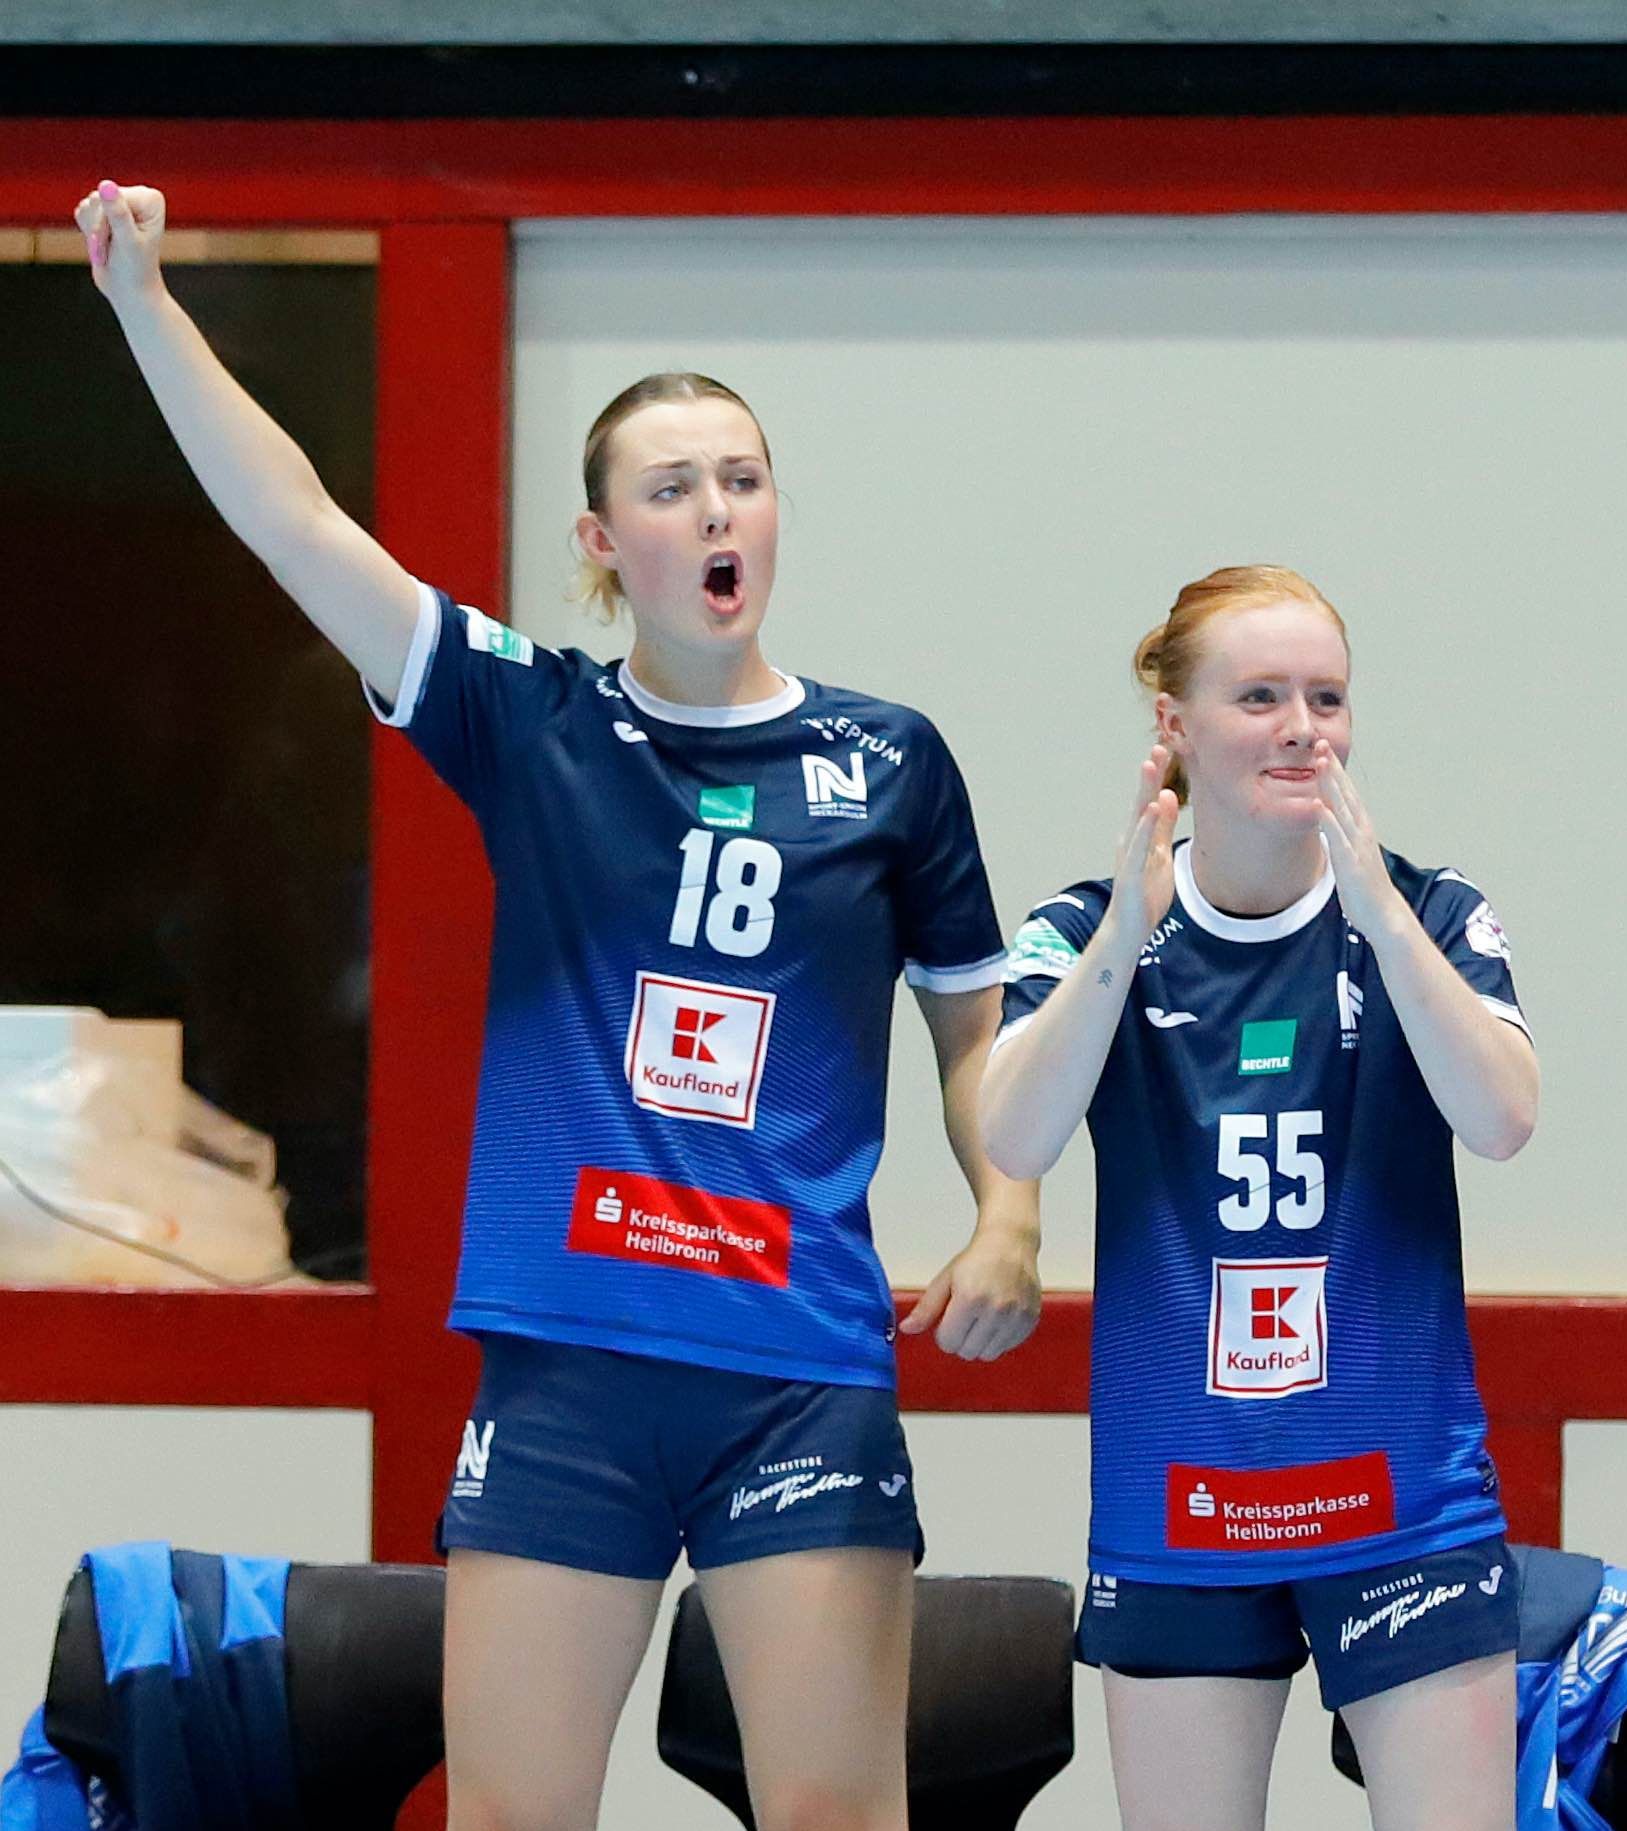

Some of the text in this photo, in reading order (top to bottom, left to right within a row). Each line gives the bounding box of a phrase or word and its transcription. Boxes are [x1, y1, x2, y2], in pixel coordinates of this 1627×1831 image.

[669, 827, 783, 958] 18
[1242, 1056, 1290, 1070] BECHTLE
[643, 1065, 739, 1098] Kaufland
[1217, 1110, 1326, 1232] 55
[629, 1208, 766, 1253] Kreissparkasse
[625, 1231, 720, 1264] Heilbronn
[1223, 1492, 1370, 1521] Kreissparkasse
[1226, 1522, 1322, 1540] Heilbronn
